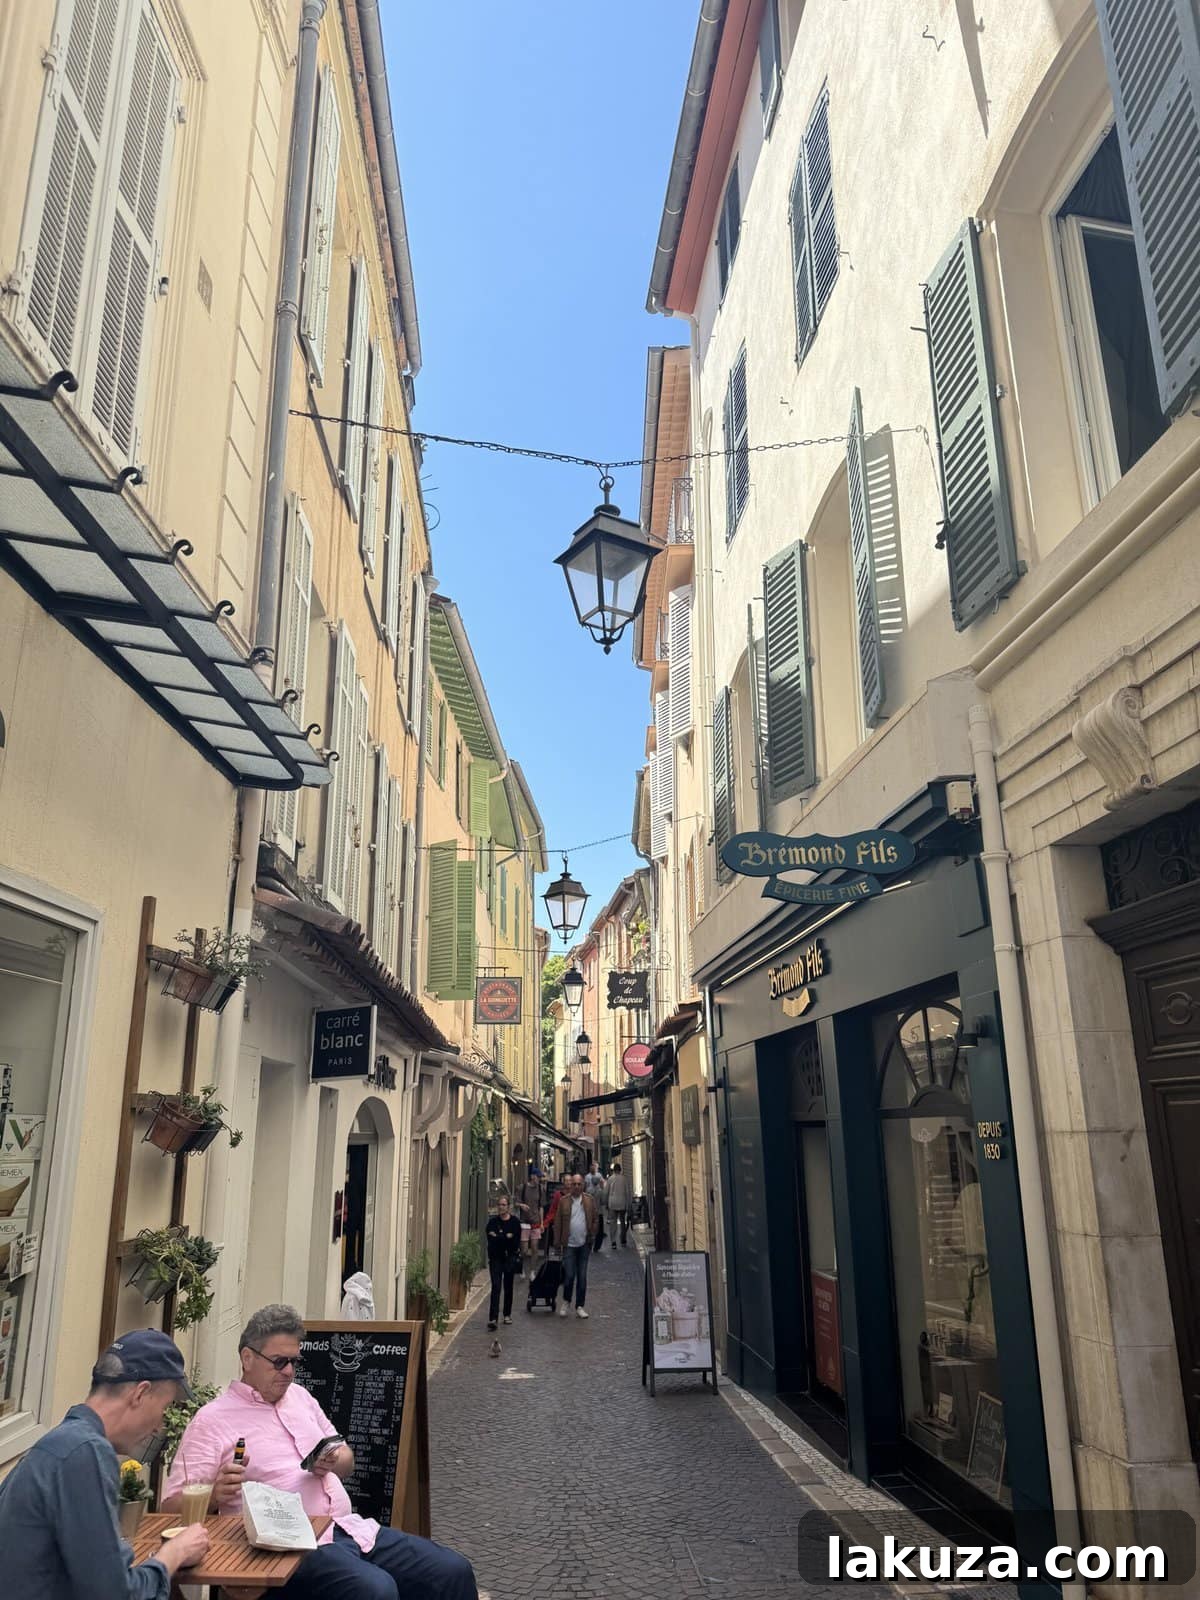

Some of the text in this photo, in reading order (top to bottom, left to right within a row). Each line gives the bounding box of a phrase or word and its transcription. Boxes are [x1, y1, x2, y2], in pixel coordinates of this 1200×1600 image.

[738, 838, 898, 868] Brémond Fils
[839, 881, 870, 899] FINE
[768, 938, 824, 999] Brémond Fils
[326, 1011, 360, 1029] carré
[320, 1032, 364, 1050] blanc
[327, 1056, 353, 1067] PARIS
[978, 1121, 1001, 1138] DEPUIS
[299, 1340, 330, 1352] omads
